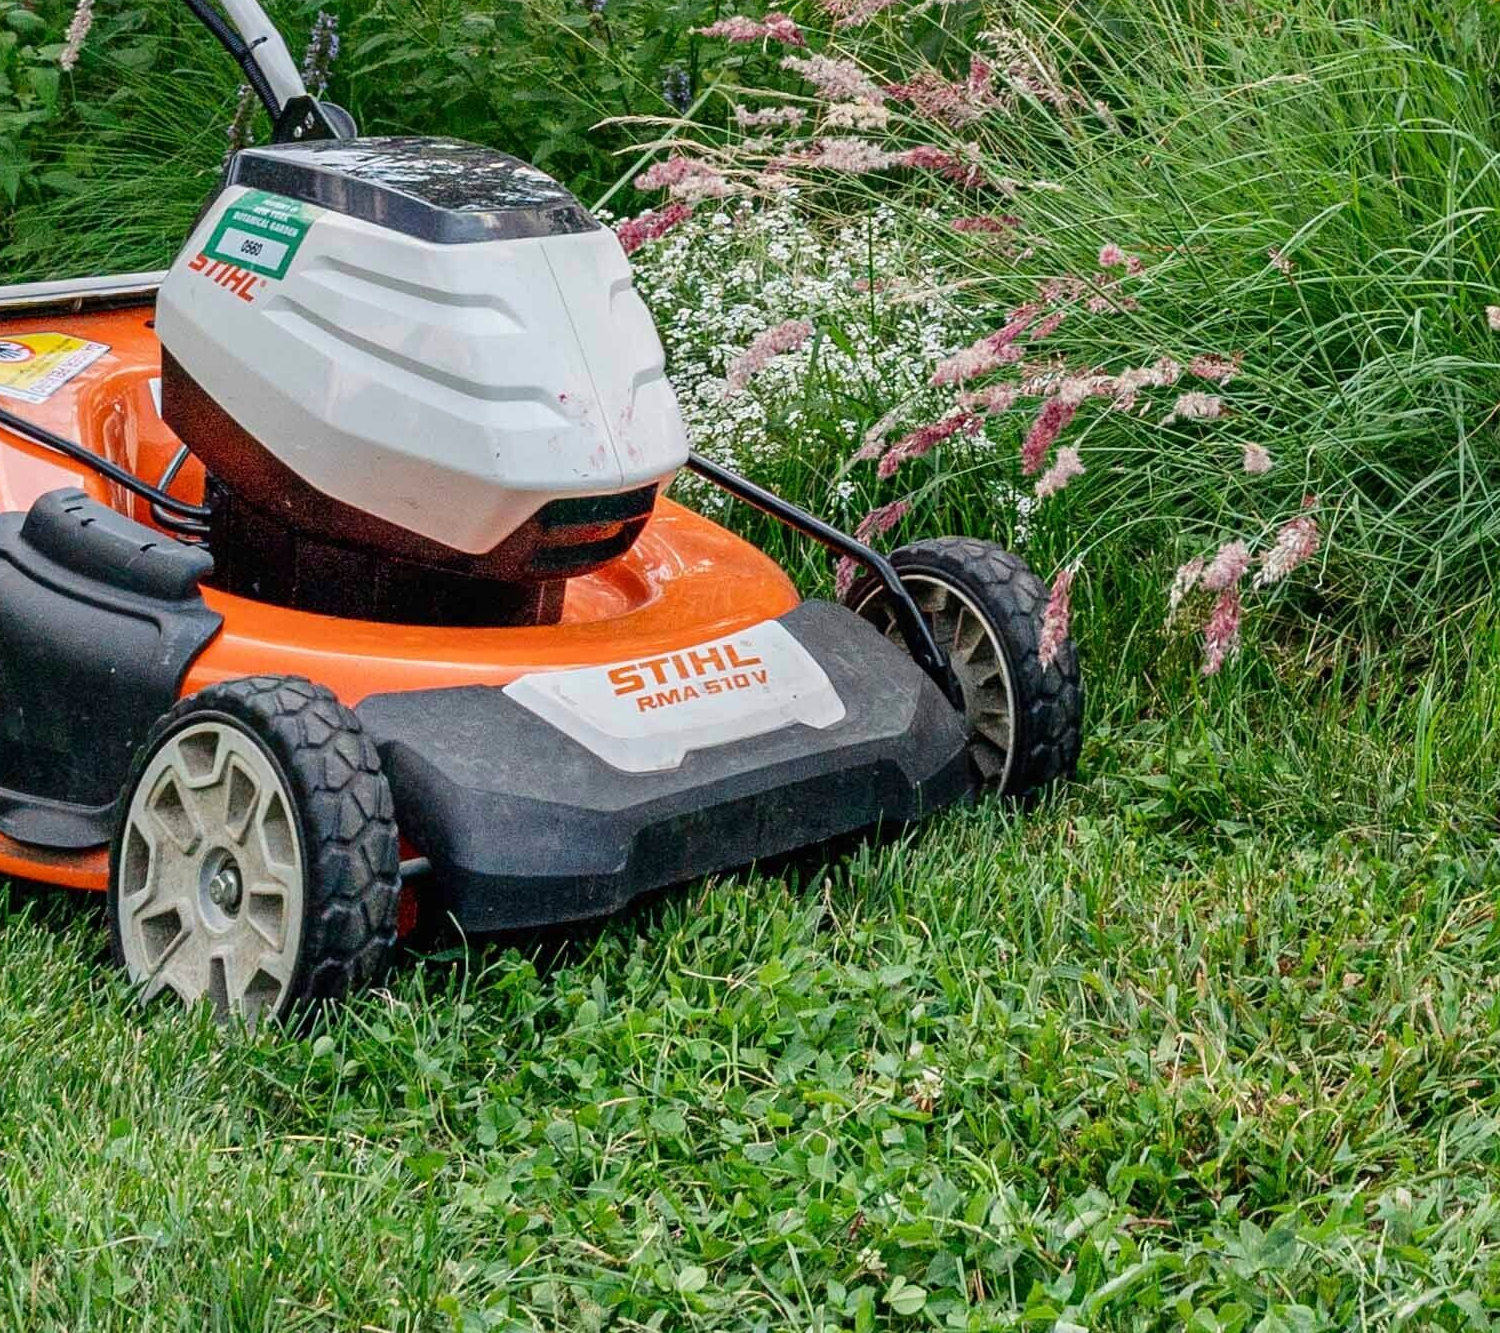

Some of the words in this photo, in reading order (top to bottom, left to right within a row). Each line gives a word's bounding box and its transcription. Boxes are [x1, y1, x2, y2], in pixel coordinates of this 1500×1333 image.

[188, 252, 258, 302] STIHL
[607, 644, 762, 696] STIHL
[636, 685, 700, 713] RMA
[704, 674, 750, 695] 510
[751, 669, 769, 684] V
